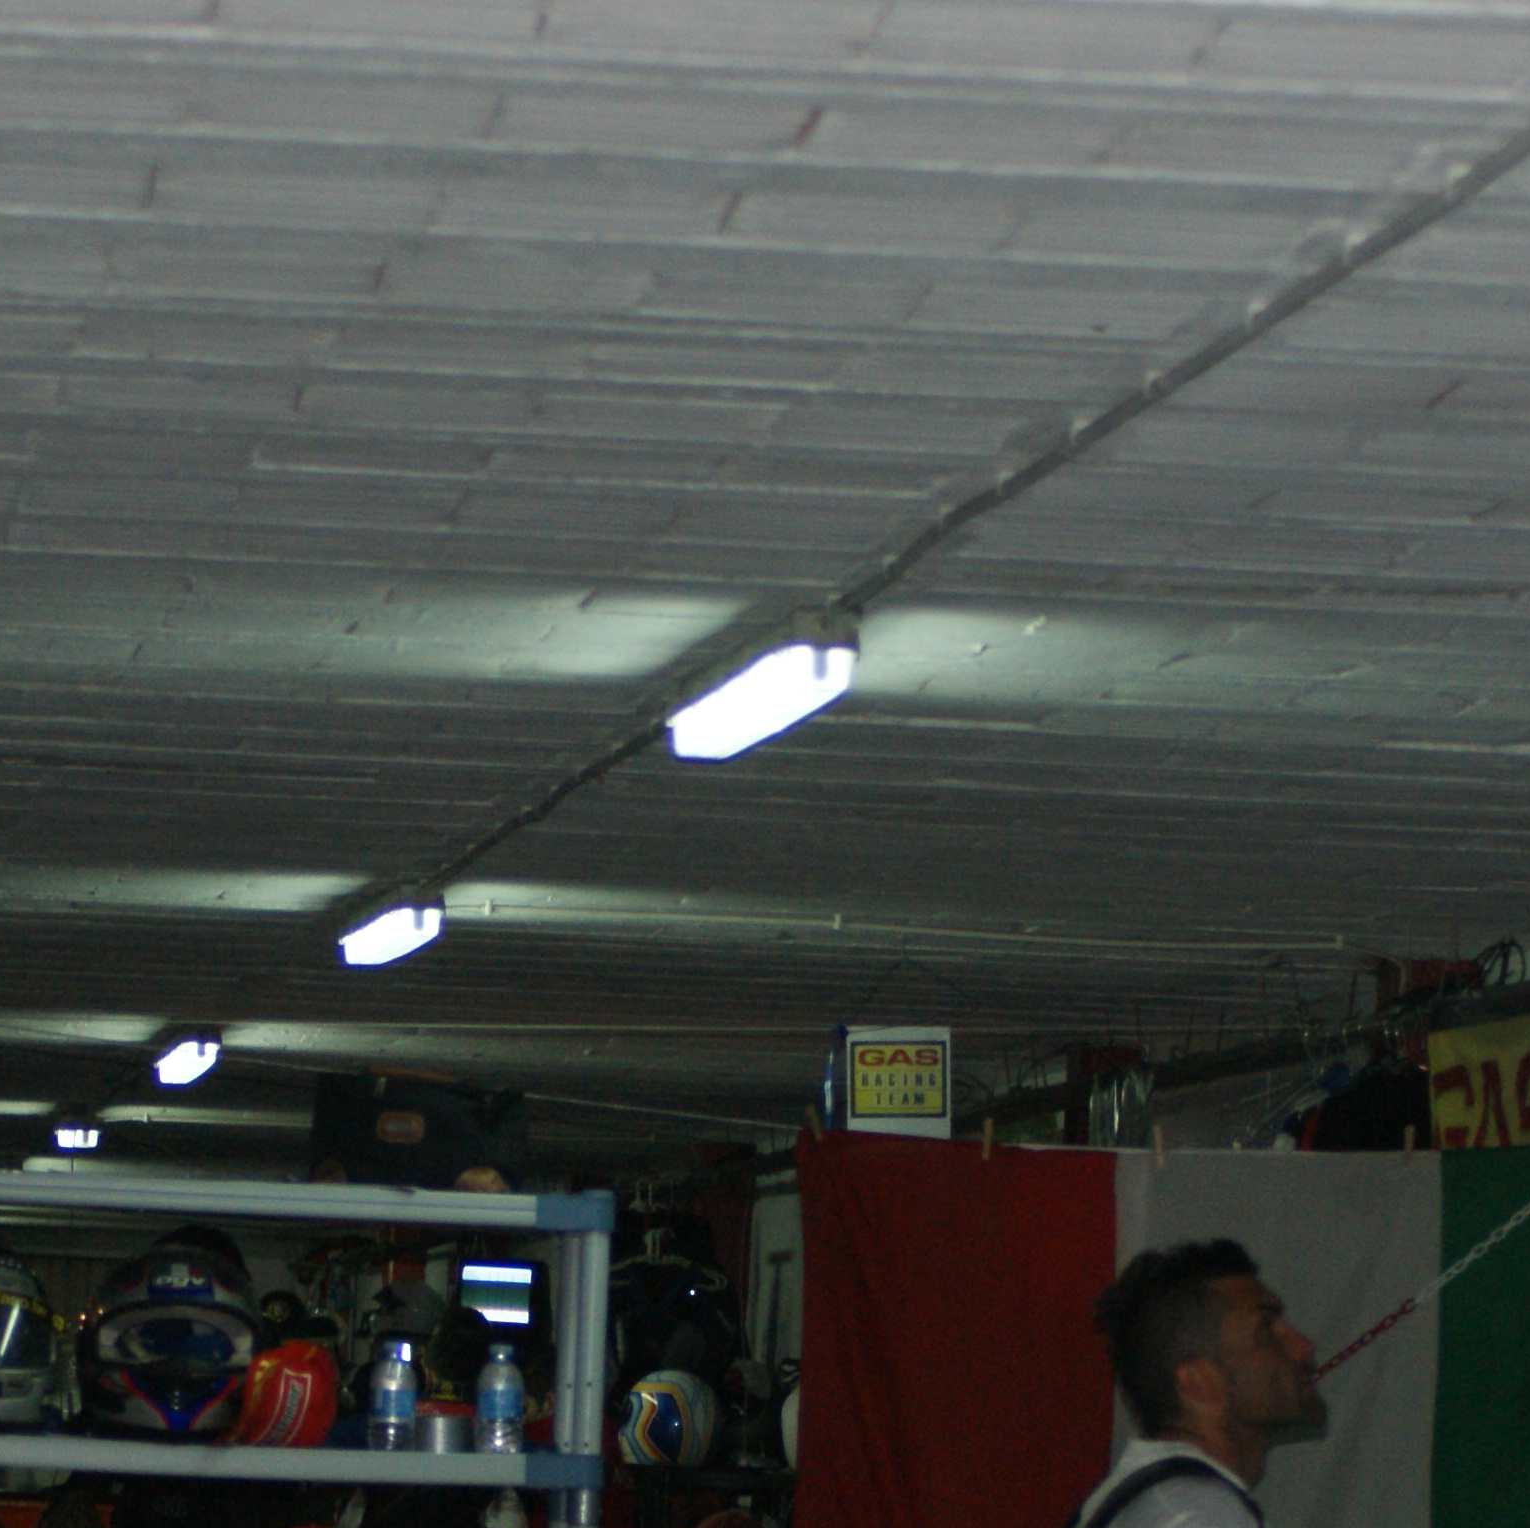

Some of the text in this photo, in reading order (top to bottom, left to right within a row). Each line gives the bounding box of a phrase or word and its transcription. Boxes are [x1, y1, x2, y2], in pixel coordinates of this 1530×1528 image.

[857, 1048, 940, 1067] GAS
[860, 1072, 937, 1087] RACING
[875, 1091, 926, 1106] TEAM
